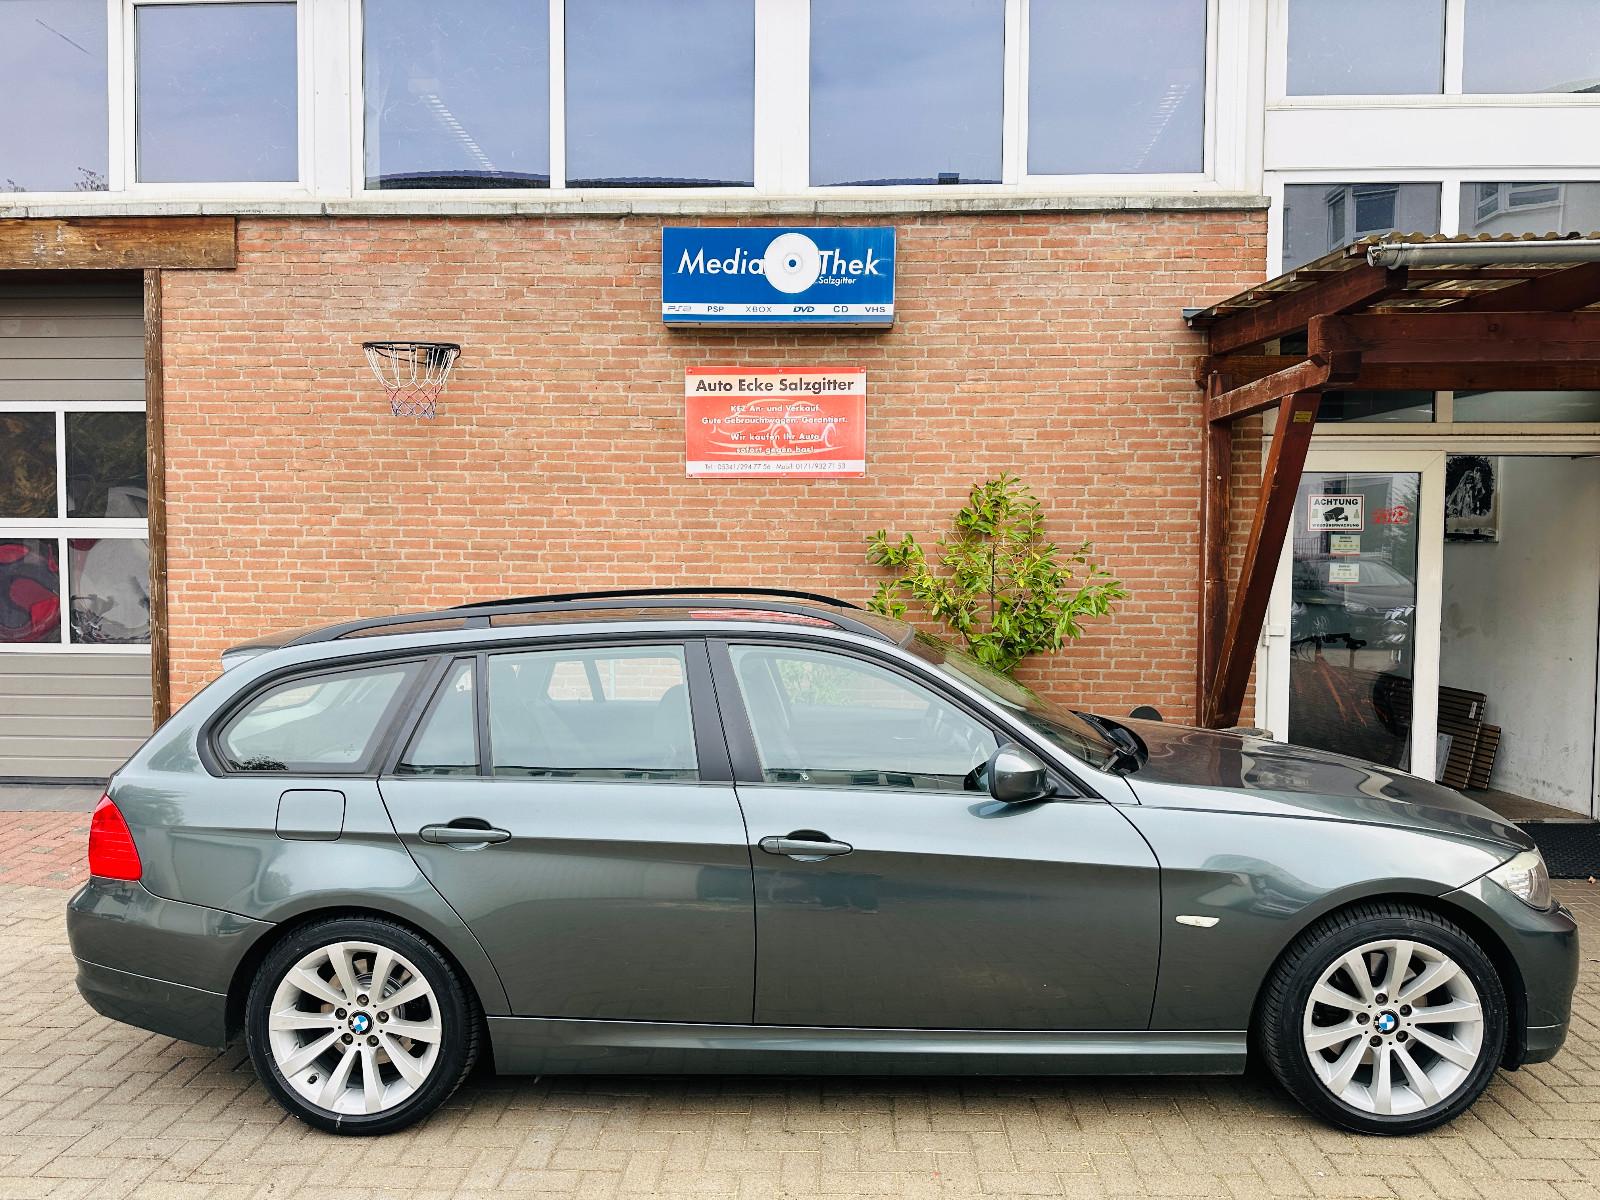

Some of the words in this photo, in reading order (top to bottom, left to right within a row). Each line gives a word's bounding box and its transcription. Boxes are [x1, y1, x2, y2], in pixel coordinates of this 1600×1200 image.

[677, 247, 766, 276] Media
[819, 248, 882, 275] Thek
[793, 305, 815, 313] DVD
[833, 305, 849, 313] CD
[695, 378, 733, 392] Auto
[738, 377, 774, 391] Ecke
[779, 376, 855, 395] Salzgitter
[766, 404, 783, 412] und
[730, 432, 746, 441] Wir
[749, 432, 780, 441] kaufen
[783, 432, 796, 440] Ihr
[765, 447, 792, 455] gegen
